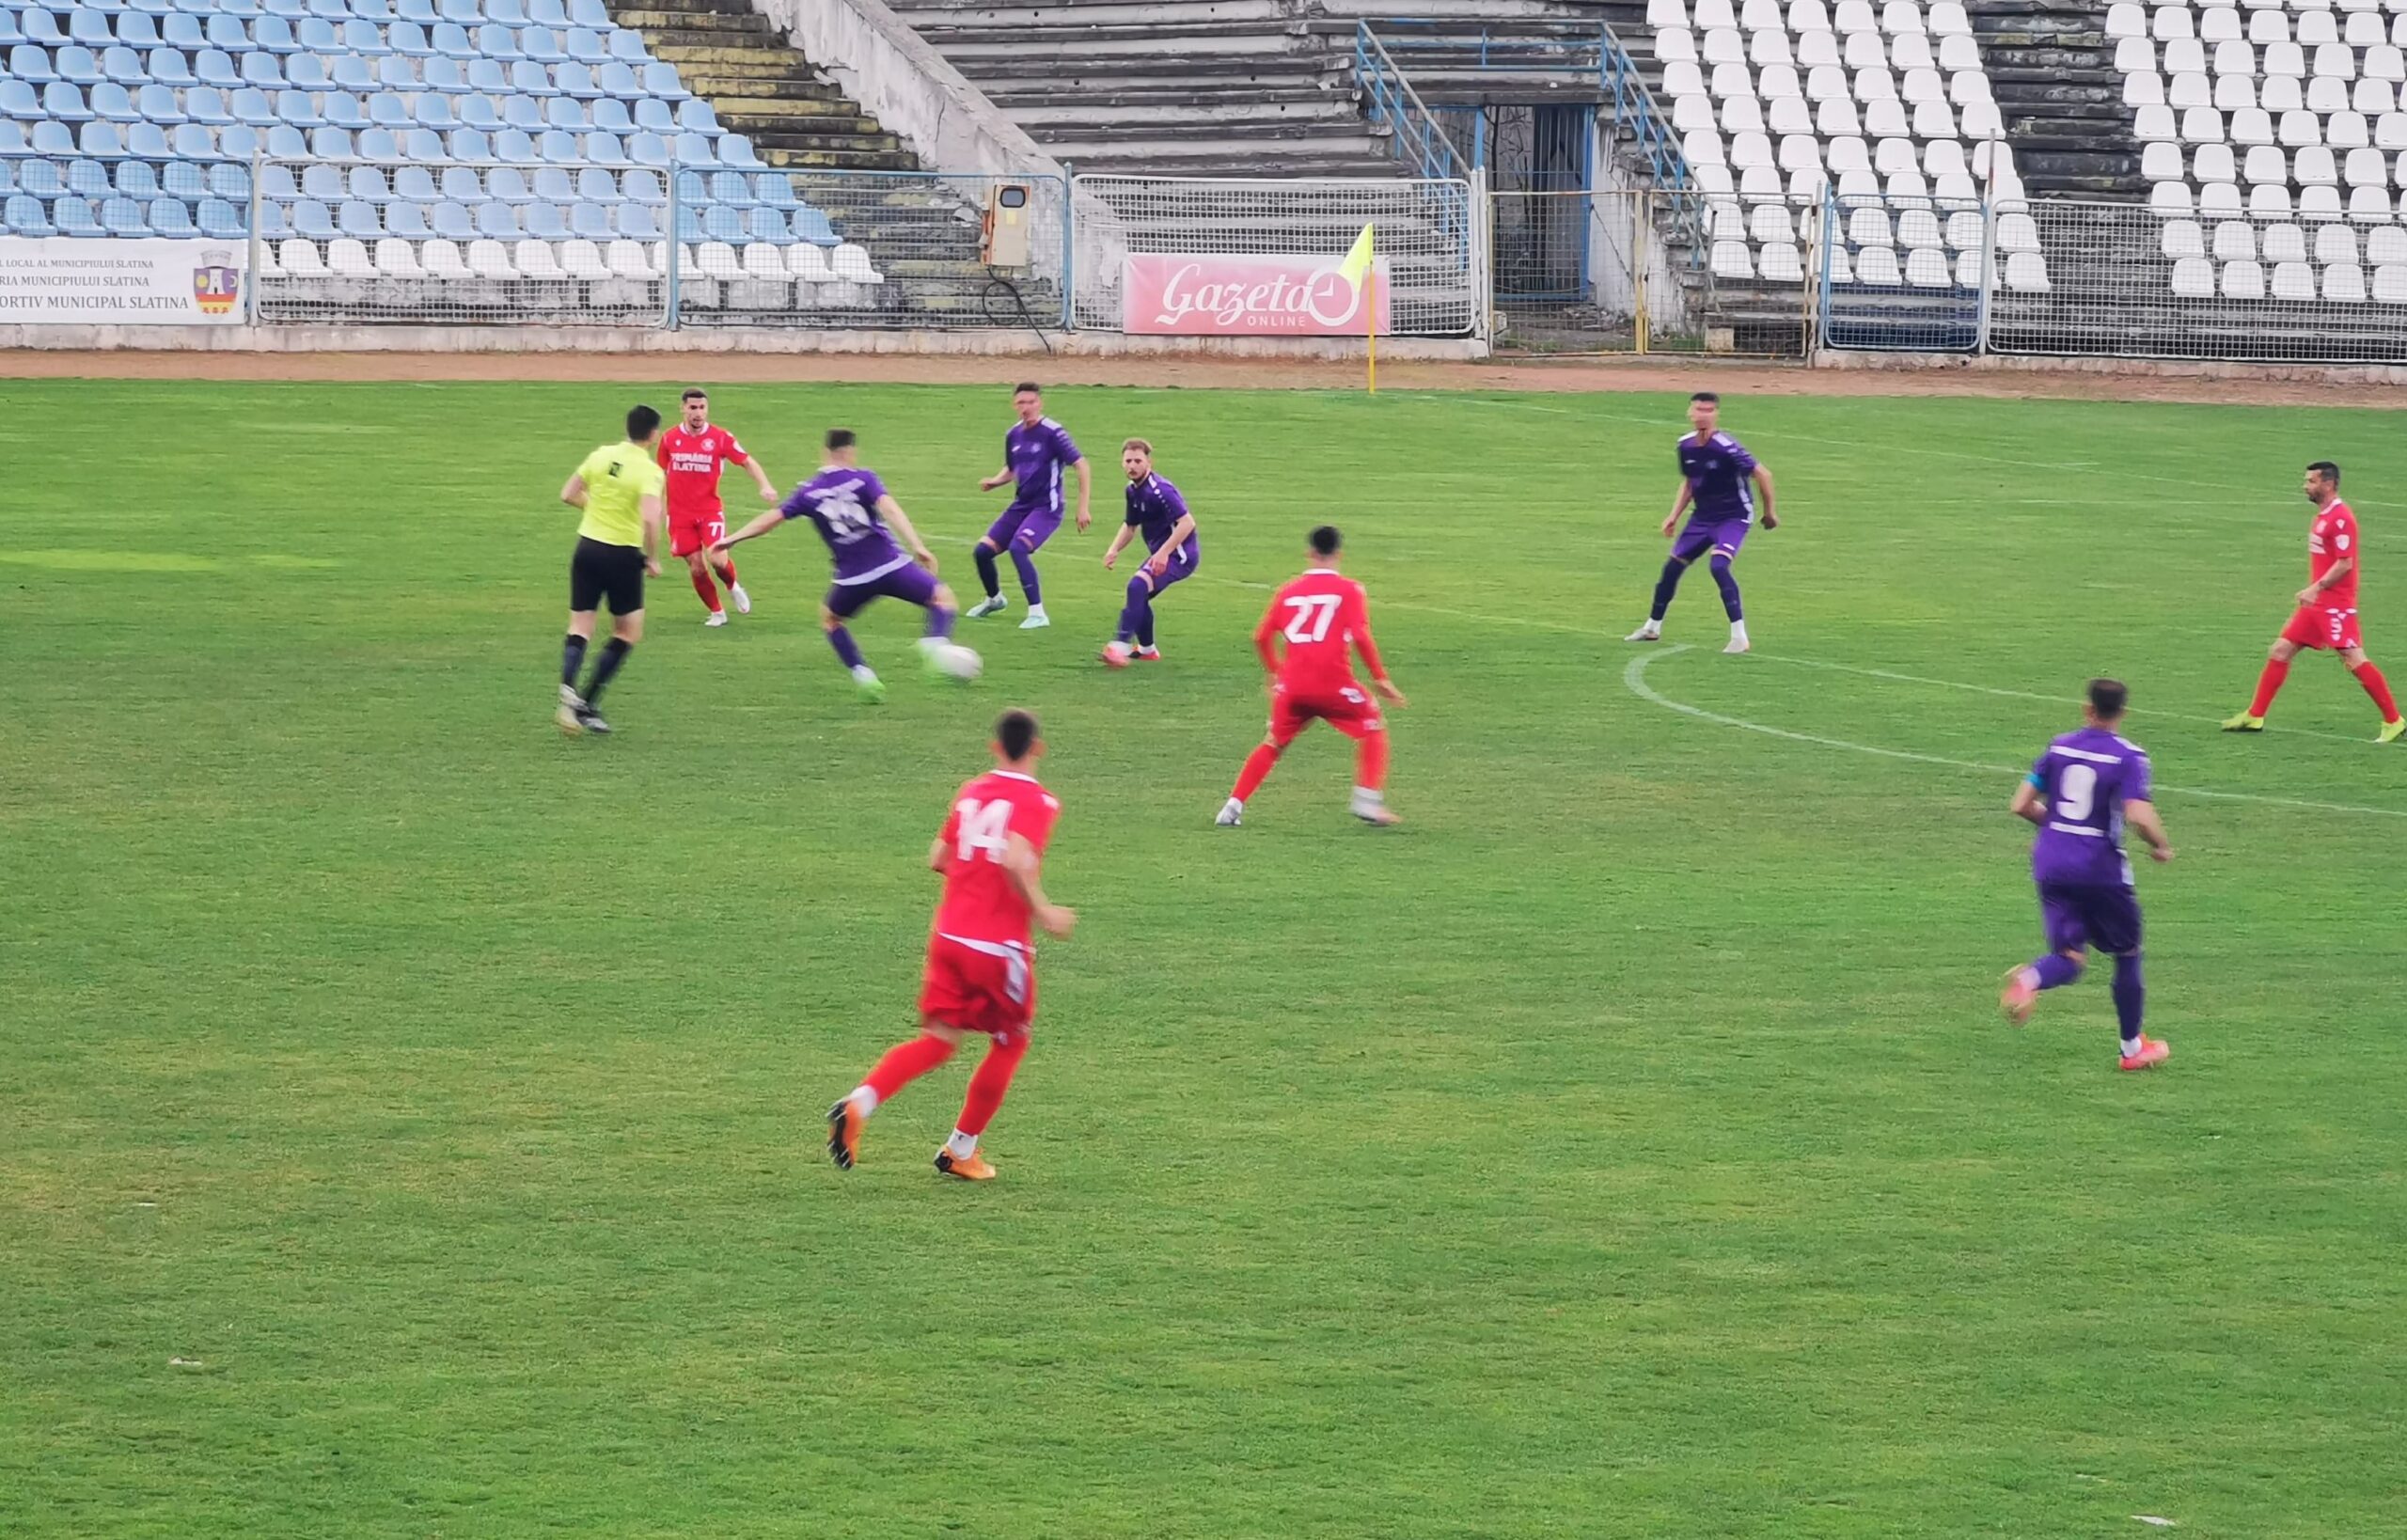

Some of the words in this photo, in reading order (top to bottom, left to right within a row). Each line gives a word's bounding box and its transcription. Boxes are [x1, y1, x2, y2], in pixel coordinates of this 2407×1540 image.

[6, 259, 36, 268] LOCAL
[37, 259, 49, 268] AL
[51, 259, 115, 269] MUNICIPIULUI
[116, 259, 154, 269] SLATINA
[0, 275, 18, 287] RIA
[21, 275, 101, 287] MUNICIPIULUI
[102, 275, 149, 287] SLATINA
[1154, 263, 1314, 326] Gazeta
[0, 295, 43, 308] ORTIV
[47, 295, 126, 309] MUNICIPAL
[129, 296, 189, 309] SLATINA
[1247, 315, 1306, 327] ONLINE
[1283, 593, 1343, 643] 27
[2056, 763, 2098, 821] 9
[954, 797, 1015, 865] 14
